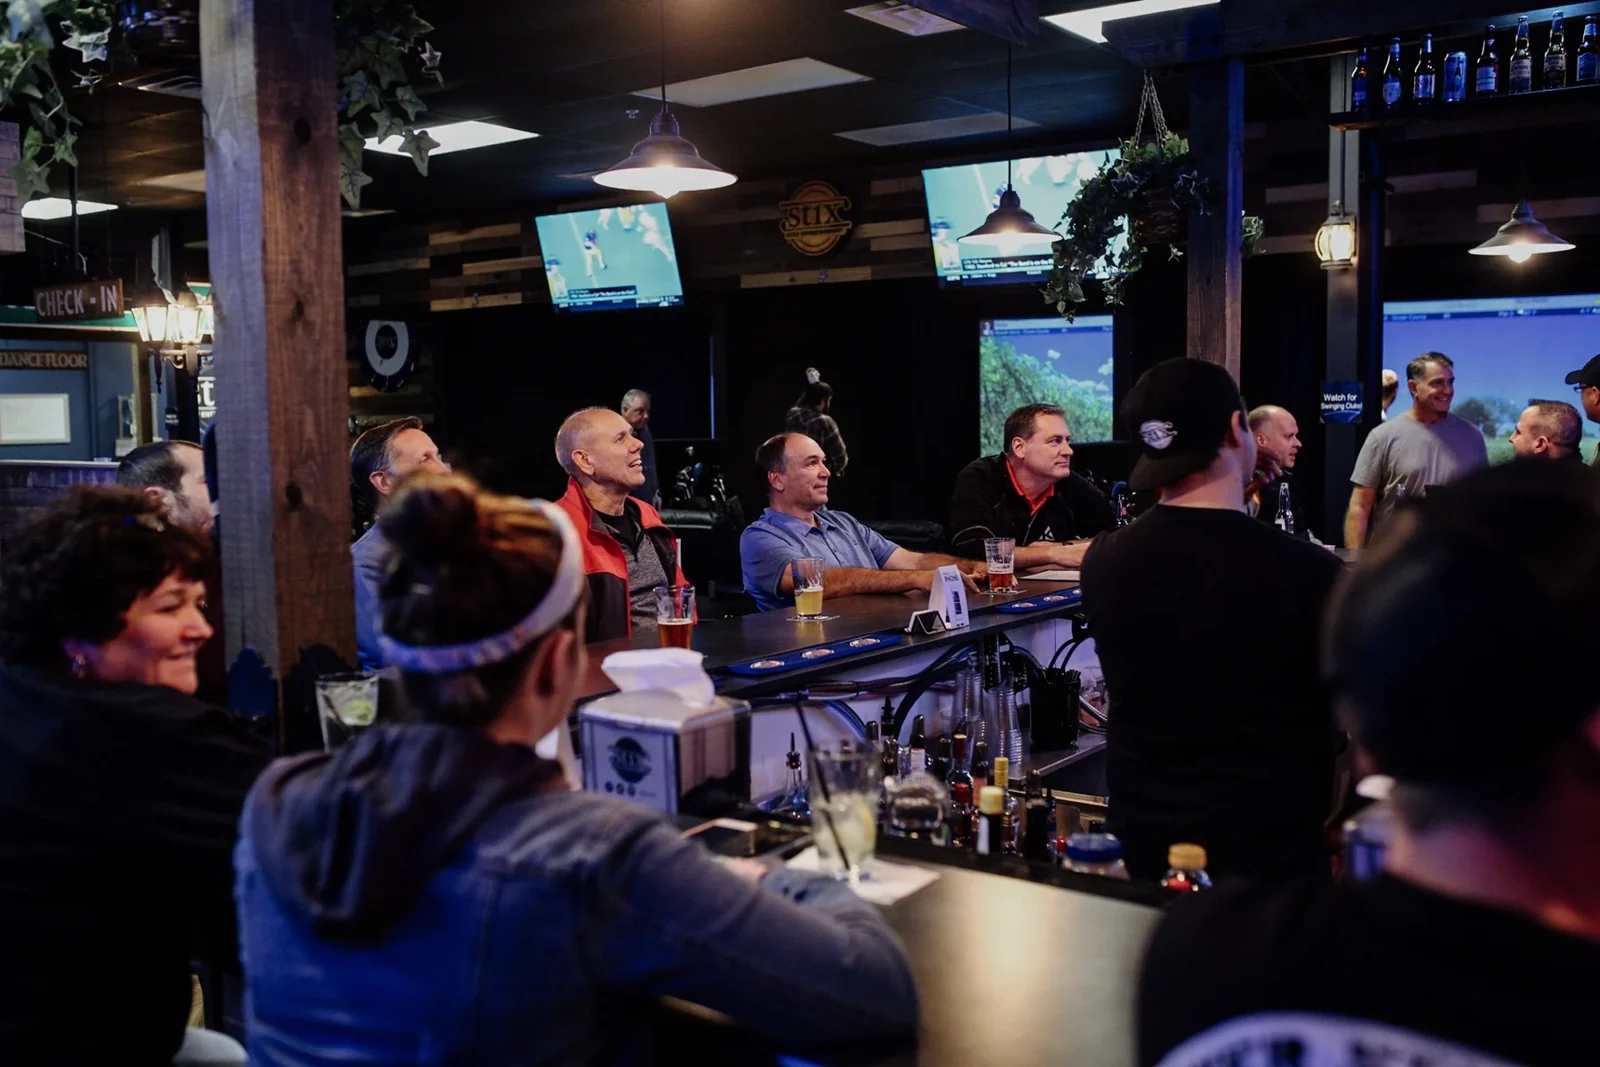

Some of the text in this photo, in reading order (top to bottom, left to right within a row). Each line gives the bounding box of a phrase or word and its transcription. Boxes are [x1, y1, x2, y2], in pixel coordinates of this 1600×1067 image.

[36, 288, 84, 316] CHECK
[100, 285, 118, 312] IN
[0, 351, 88, 368] DANCE FLOOR
[1323, 393, 1357, 401] Watch for
[1320, 402, 1344, 411] Swinging
